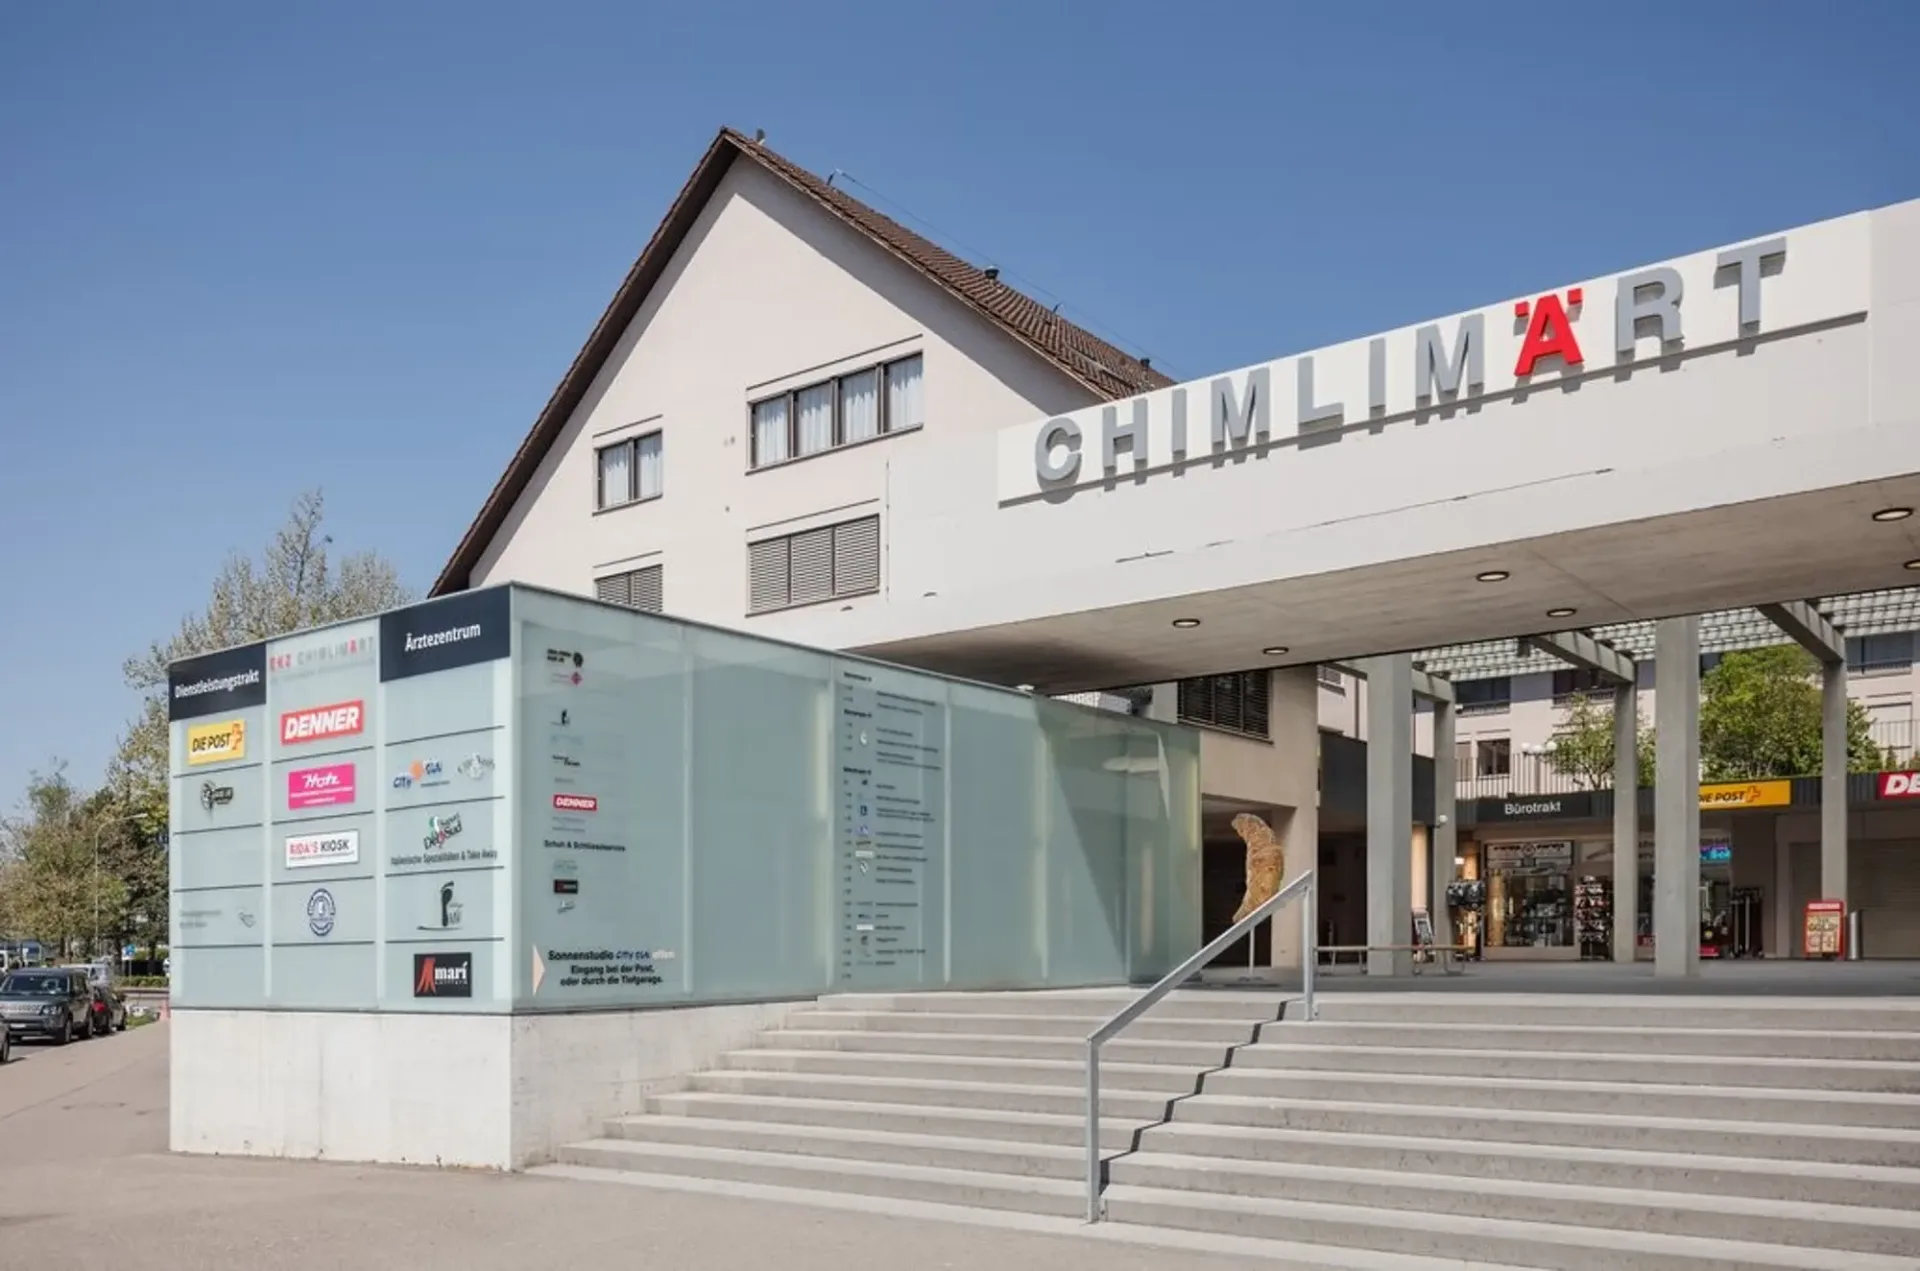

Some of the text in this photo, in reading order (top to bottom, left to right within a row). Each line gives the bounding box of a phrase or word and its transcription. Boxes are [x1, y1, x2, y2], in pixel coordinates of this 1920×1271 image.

[1035, 236, 1786, 482] CHIMLIMÄRT
[404, 623, 481, 652] Ärztezentrum
[175, 669, 259, 698] Dienstleistungstrakt
[285, 705, 361, 741] DENNER
[192, 732, 231, 752] DIE POST
[1714, 789, 1746, 801] POST
[555, 797, 596, 809] DENNER
[1504, 800, 1561, 815] Bürotrakt
[320, 839, 350, 853] KIOSK
[548, 950, 614, 960] Sonnenstudio
[570, 965, 604, 975] Eingang
[606, 964, 619, 973] bei
[620, 964, 633, 973] der
[560, 977, 579, 986] oder
[581, 976, 605, 986] durch
